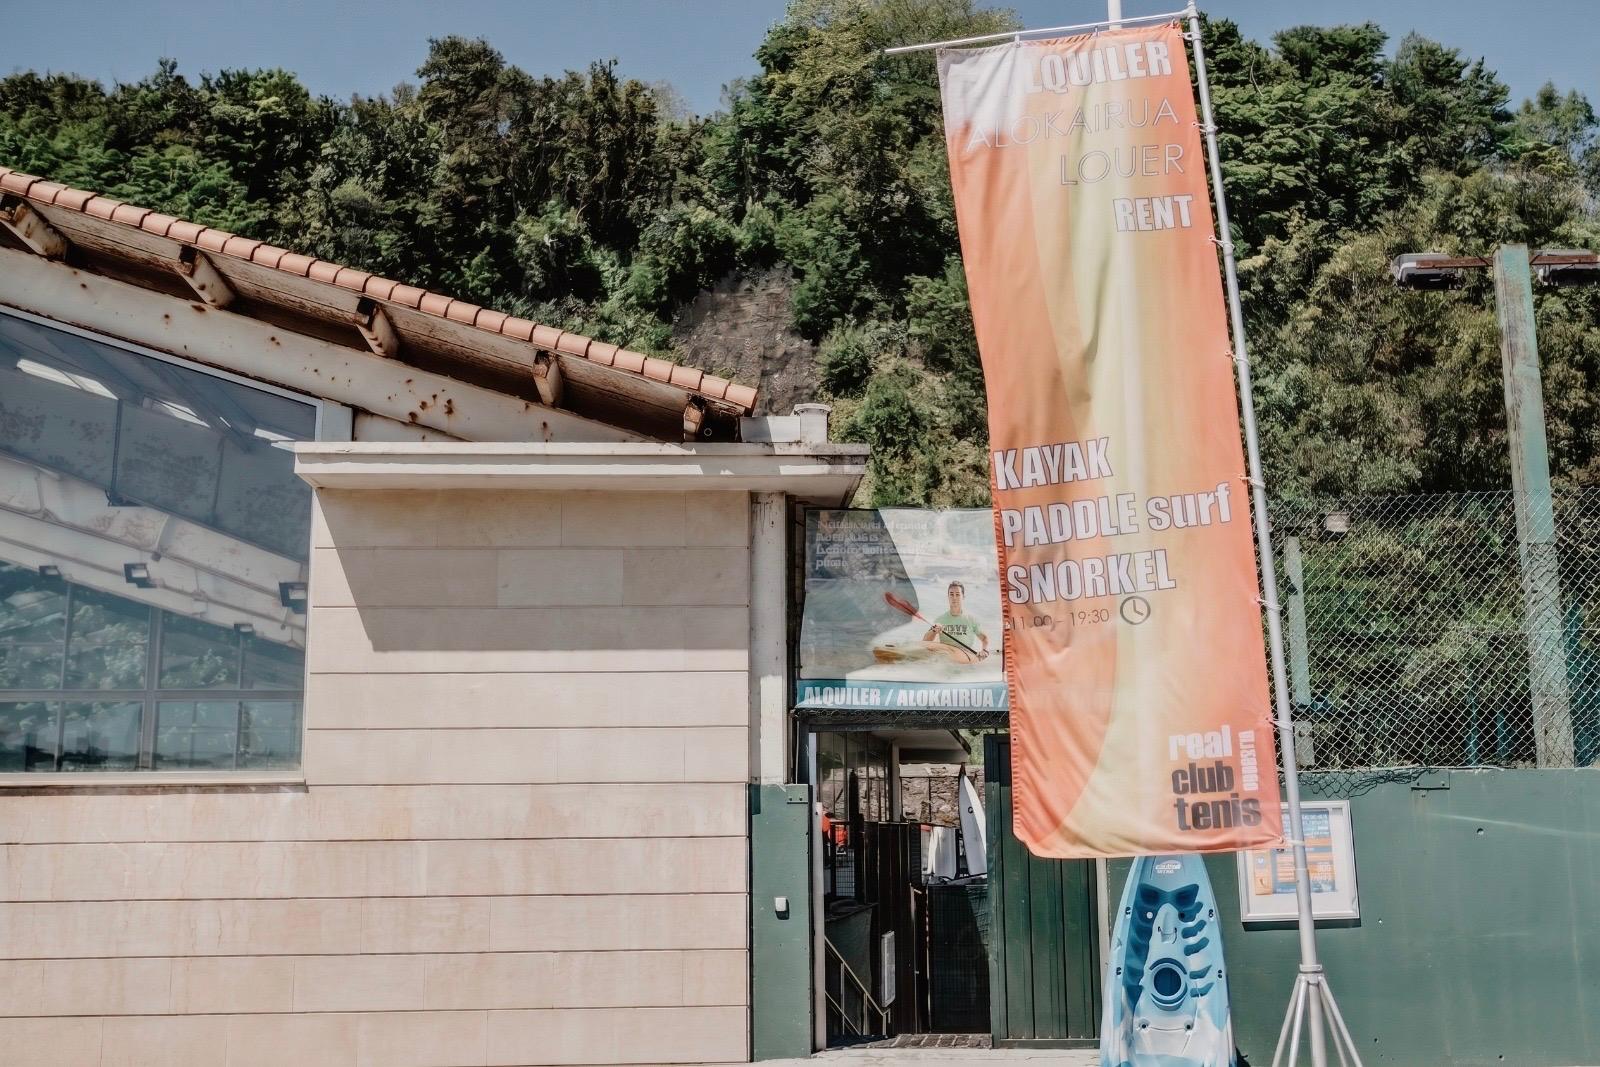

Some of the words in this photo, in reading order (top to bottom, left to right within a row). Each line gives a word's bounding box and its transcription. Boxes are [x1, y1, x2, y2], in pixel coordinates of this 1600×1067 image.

[1023, 41, 1172, 94] LQUILER
[966, 98, 1178, 151] ALOKAIRUA
[1060, 144, 1184, 186] LOUER
[1113, 195, 1193, 232] RENT
[993, 437, 1113, 490] KAYAK
[1001, 493, 1139, 547] PADDLE
[1146, 481, 1232, 531] surf
[1007, 549, 1177, 605] SNORKEL
[1069, 608, 1110, 627] 19:30
[804, 686, 881, 706] ALQUILER
[897, 689, 994, 708] ALOKAIRUA
[1168, 724, 1233, 761] real
[1171, 760, 1235, 795] club
[1173, 793, 1262, 831] tenis
